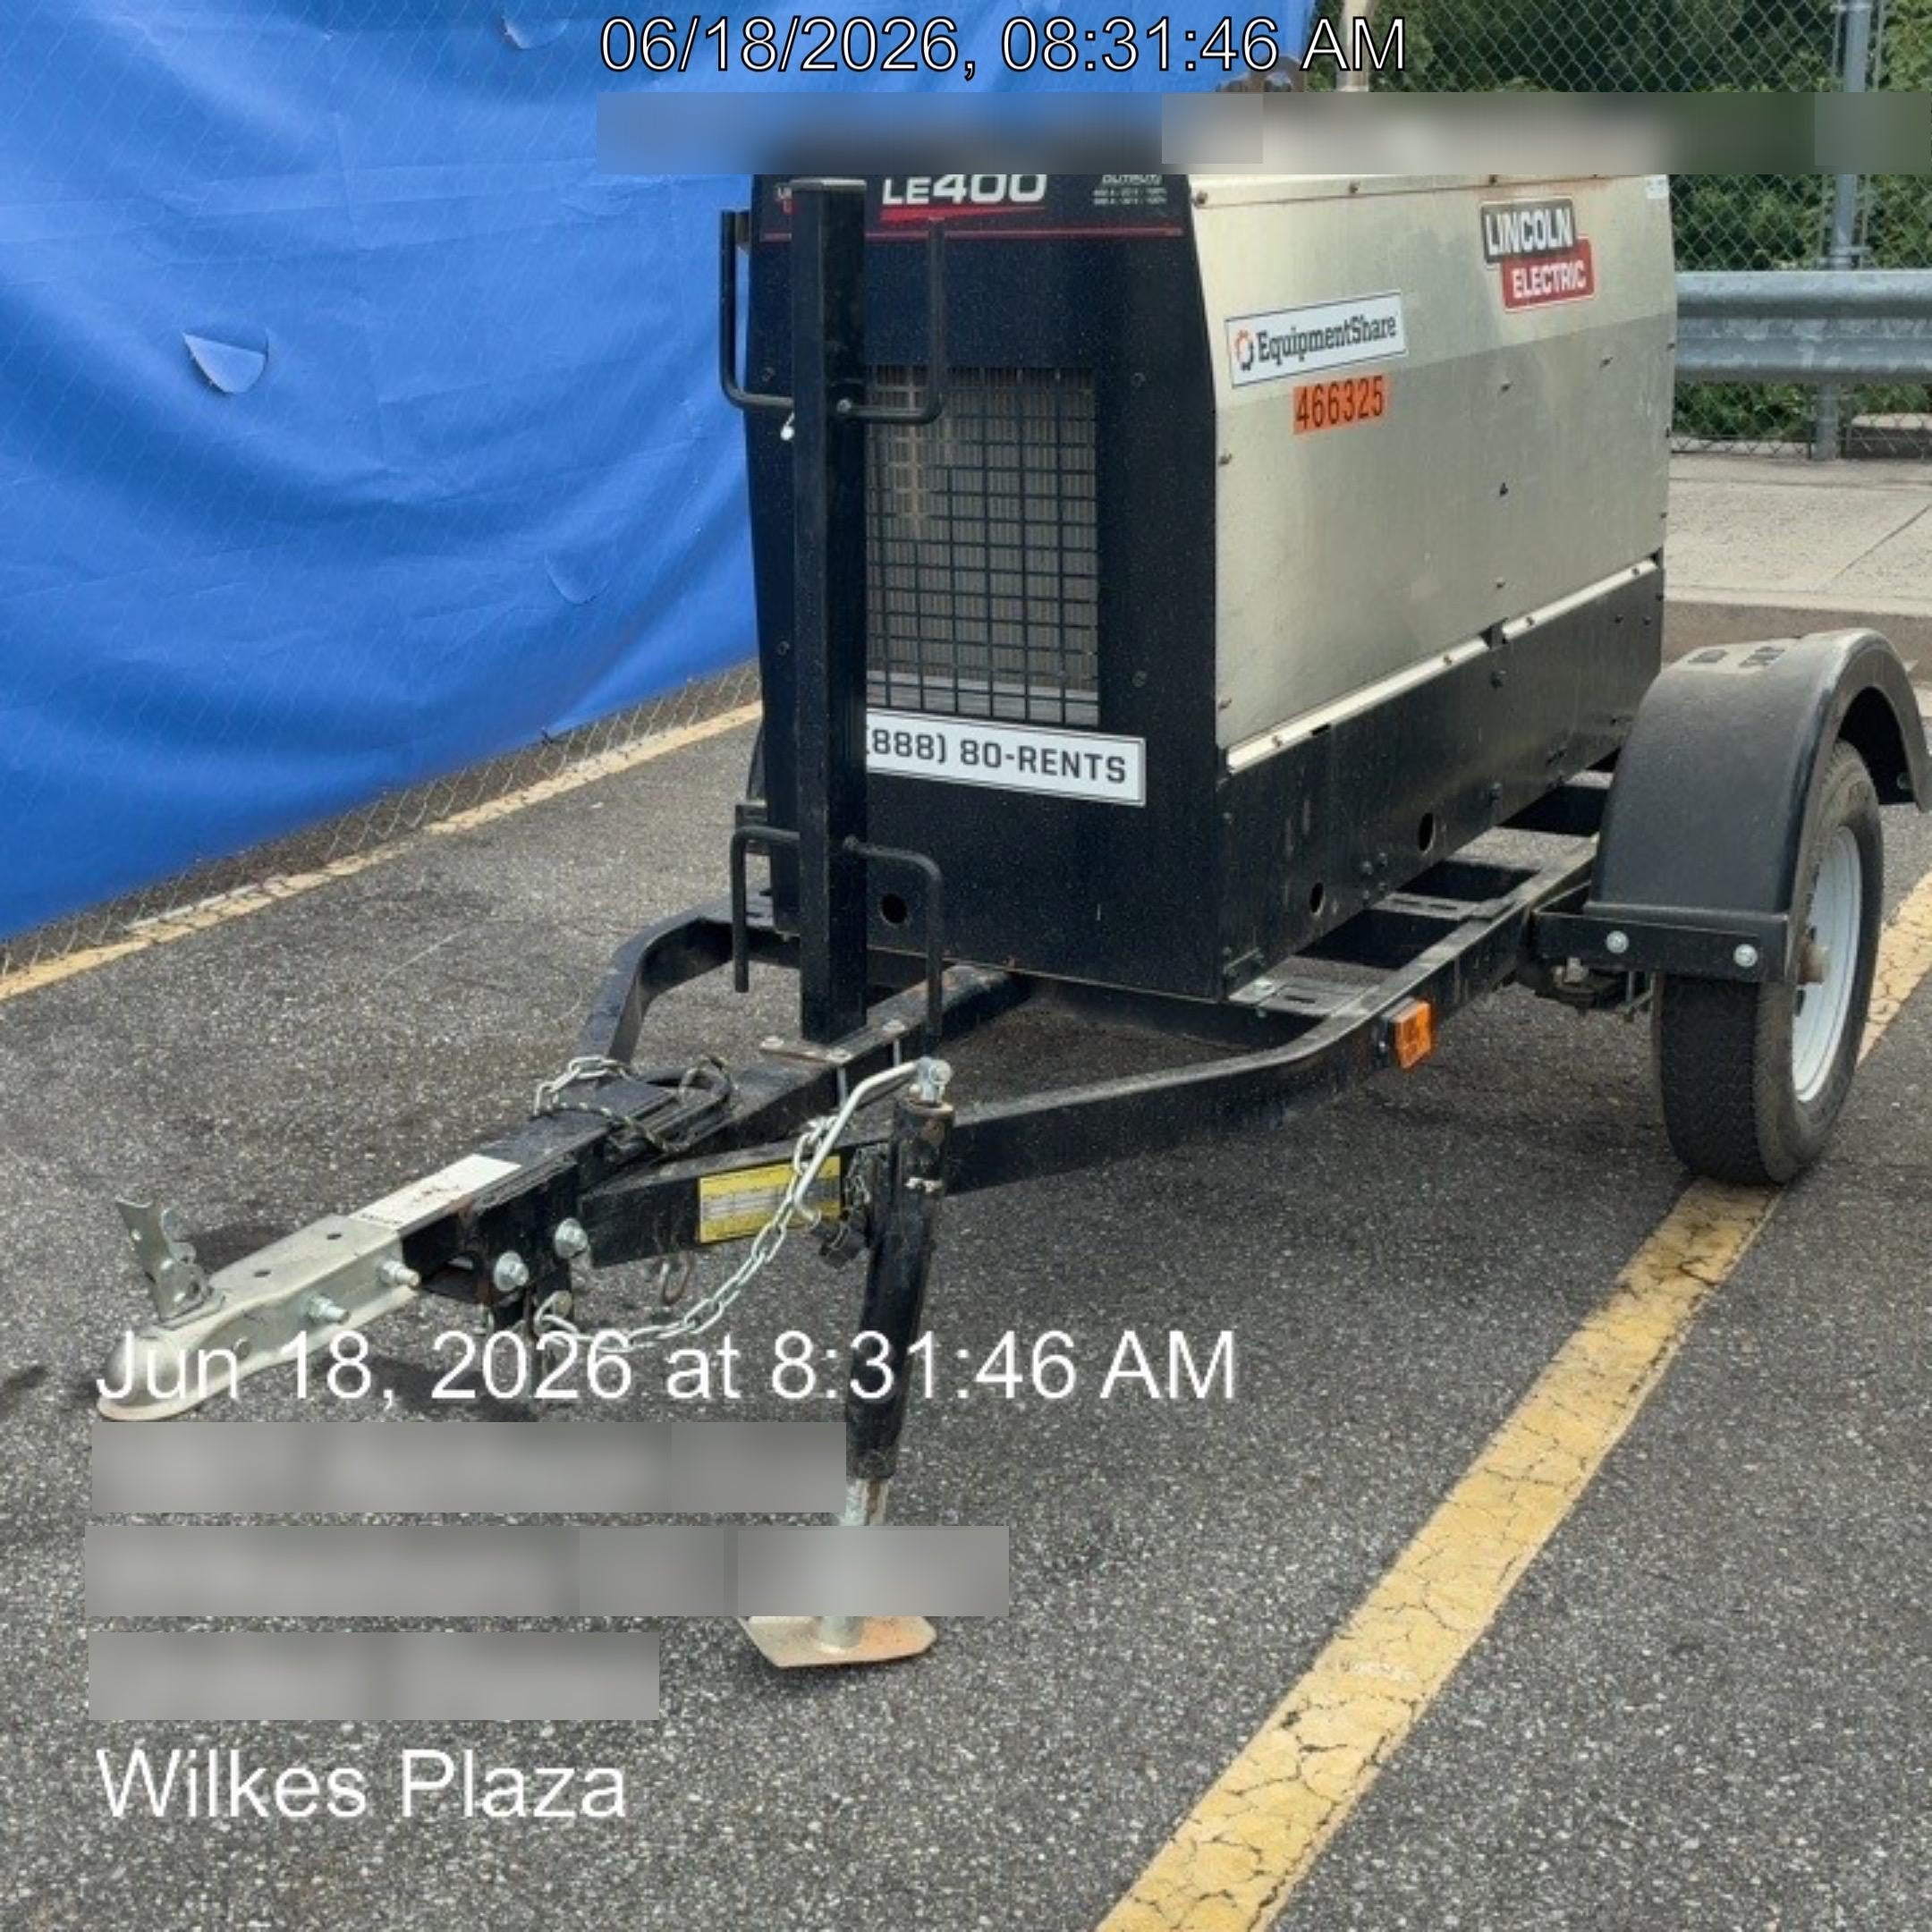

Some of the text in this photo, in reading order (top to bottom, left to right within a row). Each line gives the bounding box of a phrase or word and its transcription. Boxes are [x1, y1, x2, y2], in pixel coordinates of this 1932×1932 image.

[882, 174, 1047, 206] LE400
[1486, 208, 1573, 256] LINCOLN
[1512, 260, 1587, 299] ELECTRIC
[1257, 314, 1397, 366] EquipmentShare
[1296, 375, 1384, 430] 466325
[960, 739, 1126, 784] 80-RENTS
